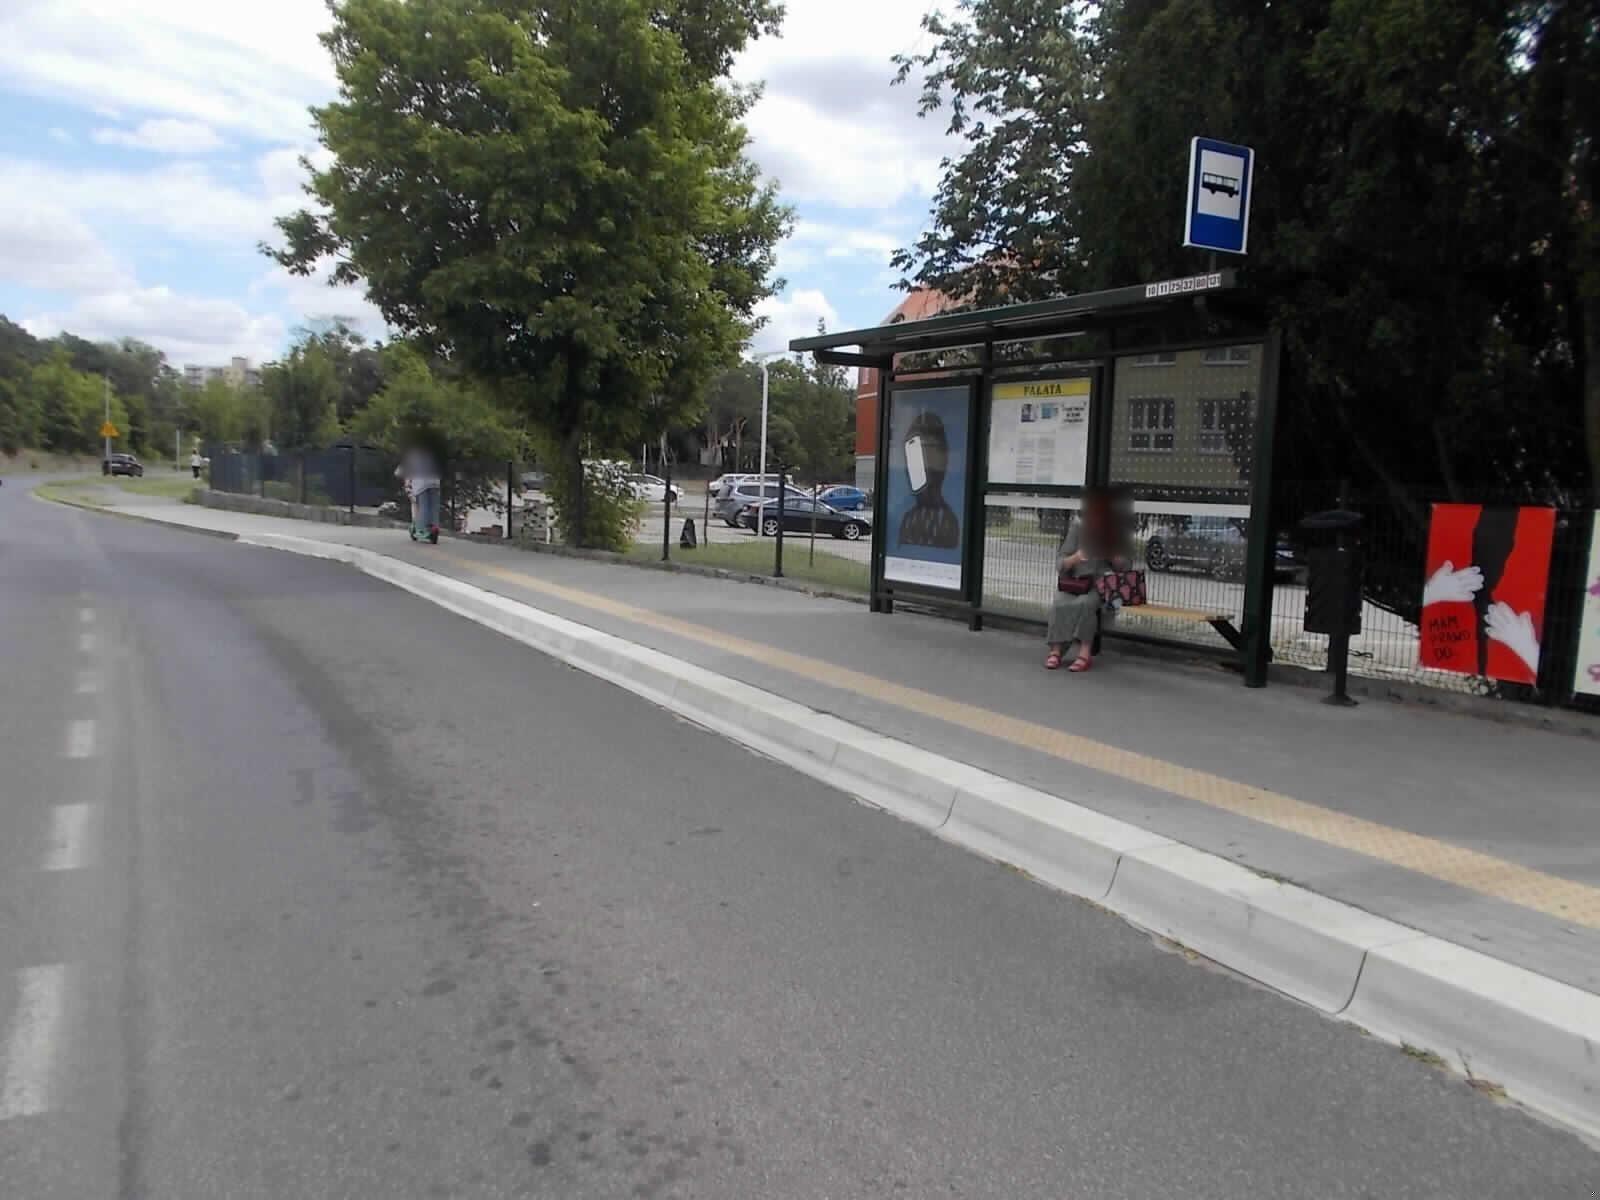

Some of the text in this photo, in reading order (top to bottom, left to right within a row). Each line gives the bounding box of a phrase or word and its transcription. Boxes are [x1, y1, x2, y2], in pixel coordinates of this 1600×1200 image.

[1147, 285, 1157, 296] 10
[1159, 283, 1168, 294] 11
[1429, 616, 1458, 632] MAM
